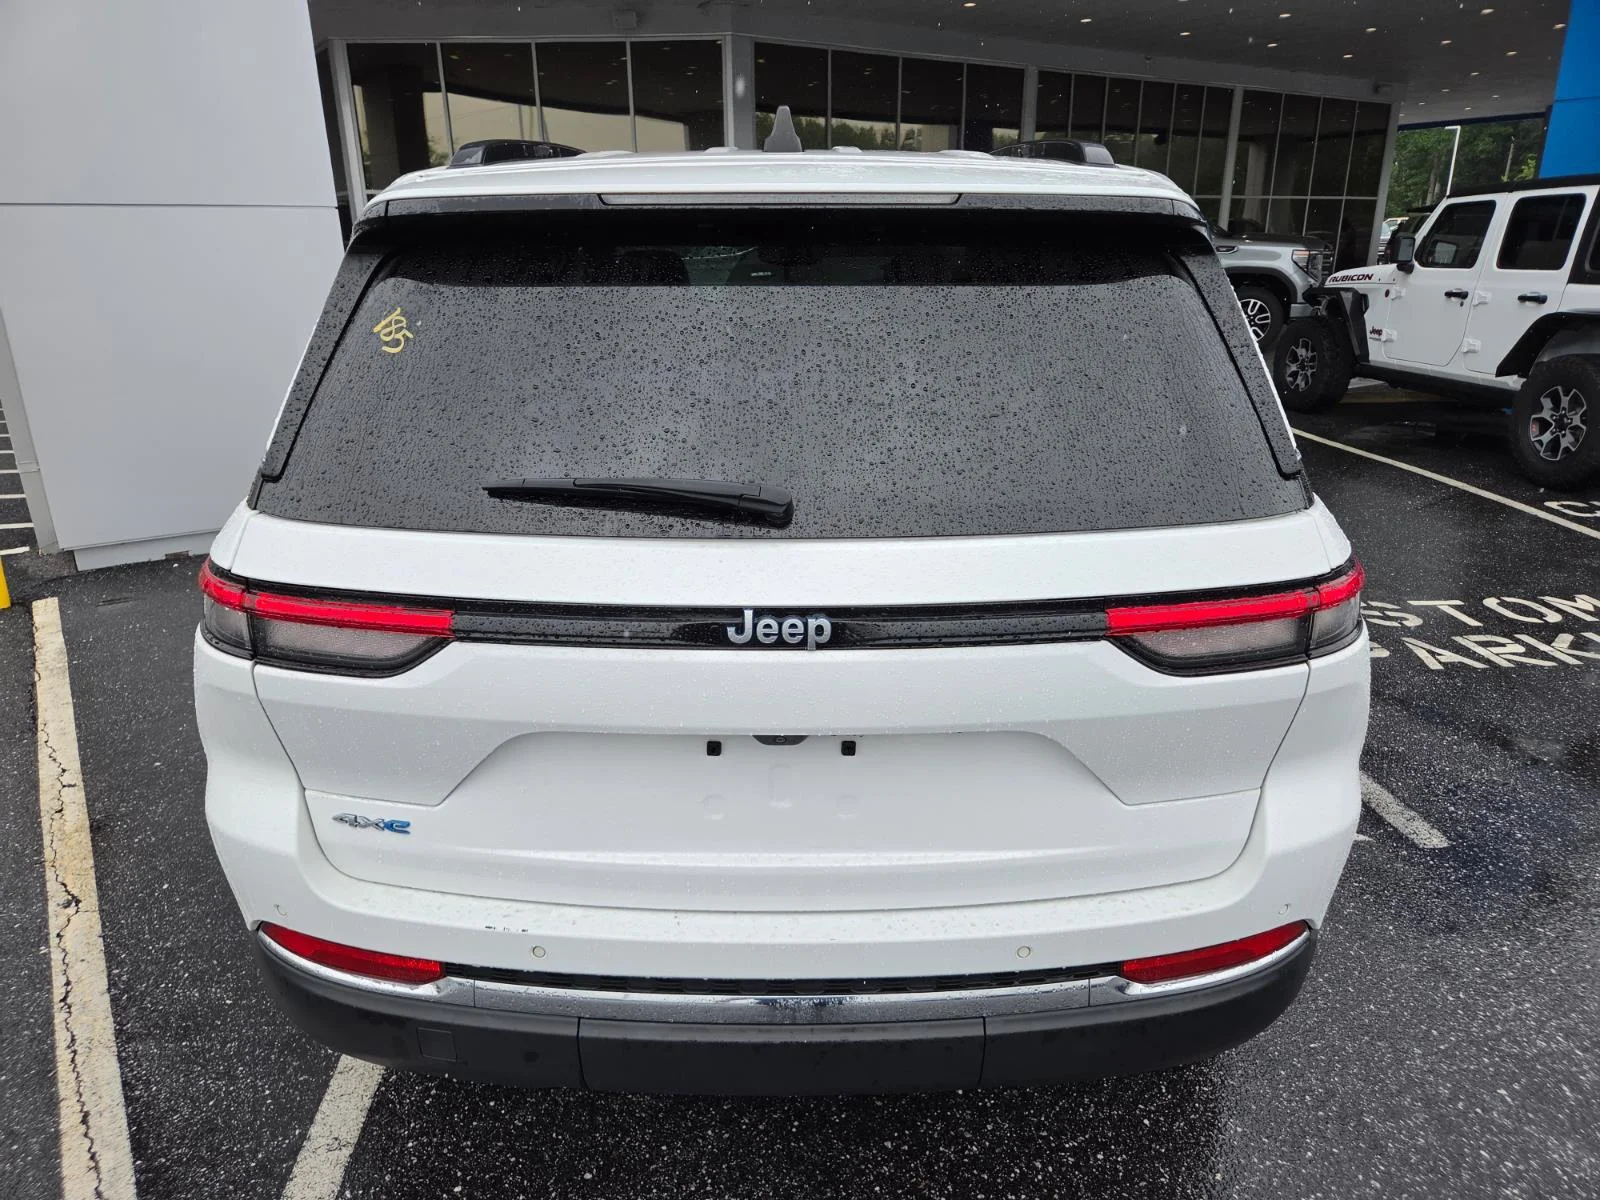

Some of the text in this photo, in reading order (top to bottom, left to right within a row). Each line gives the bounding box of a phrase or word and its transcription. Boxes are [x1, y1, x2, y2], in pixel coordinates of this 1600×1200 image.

[1328, 273, 1374, 283] RUBICON
[726, 609, 832, 651] Jeep
[1369, 632, 1600, 670] ARK
